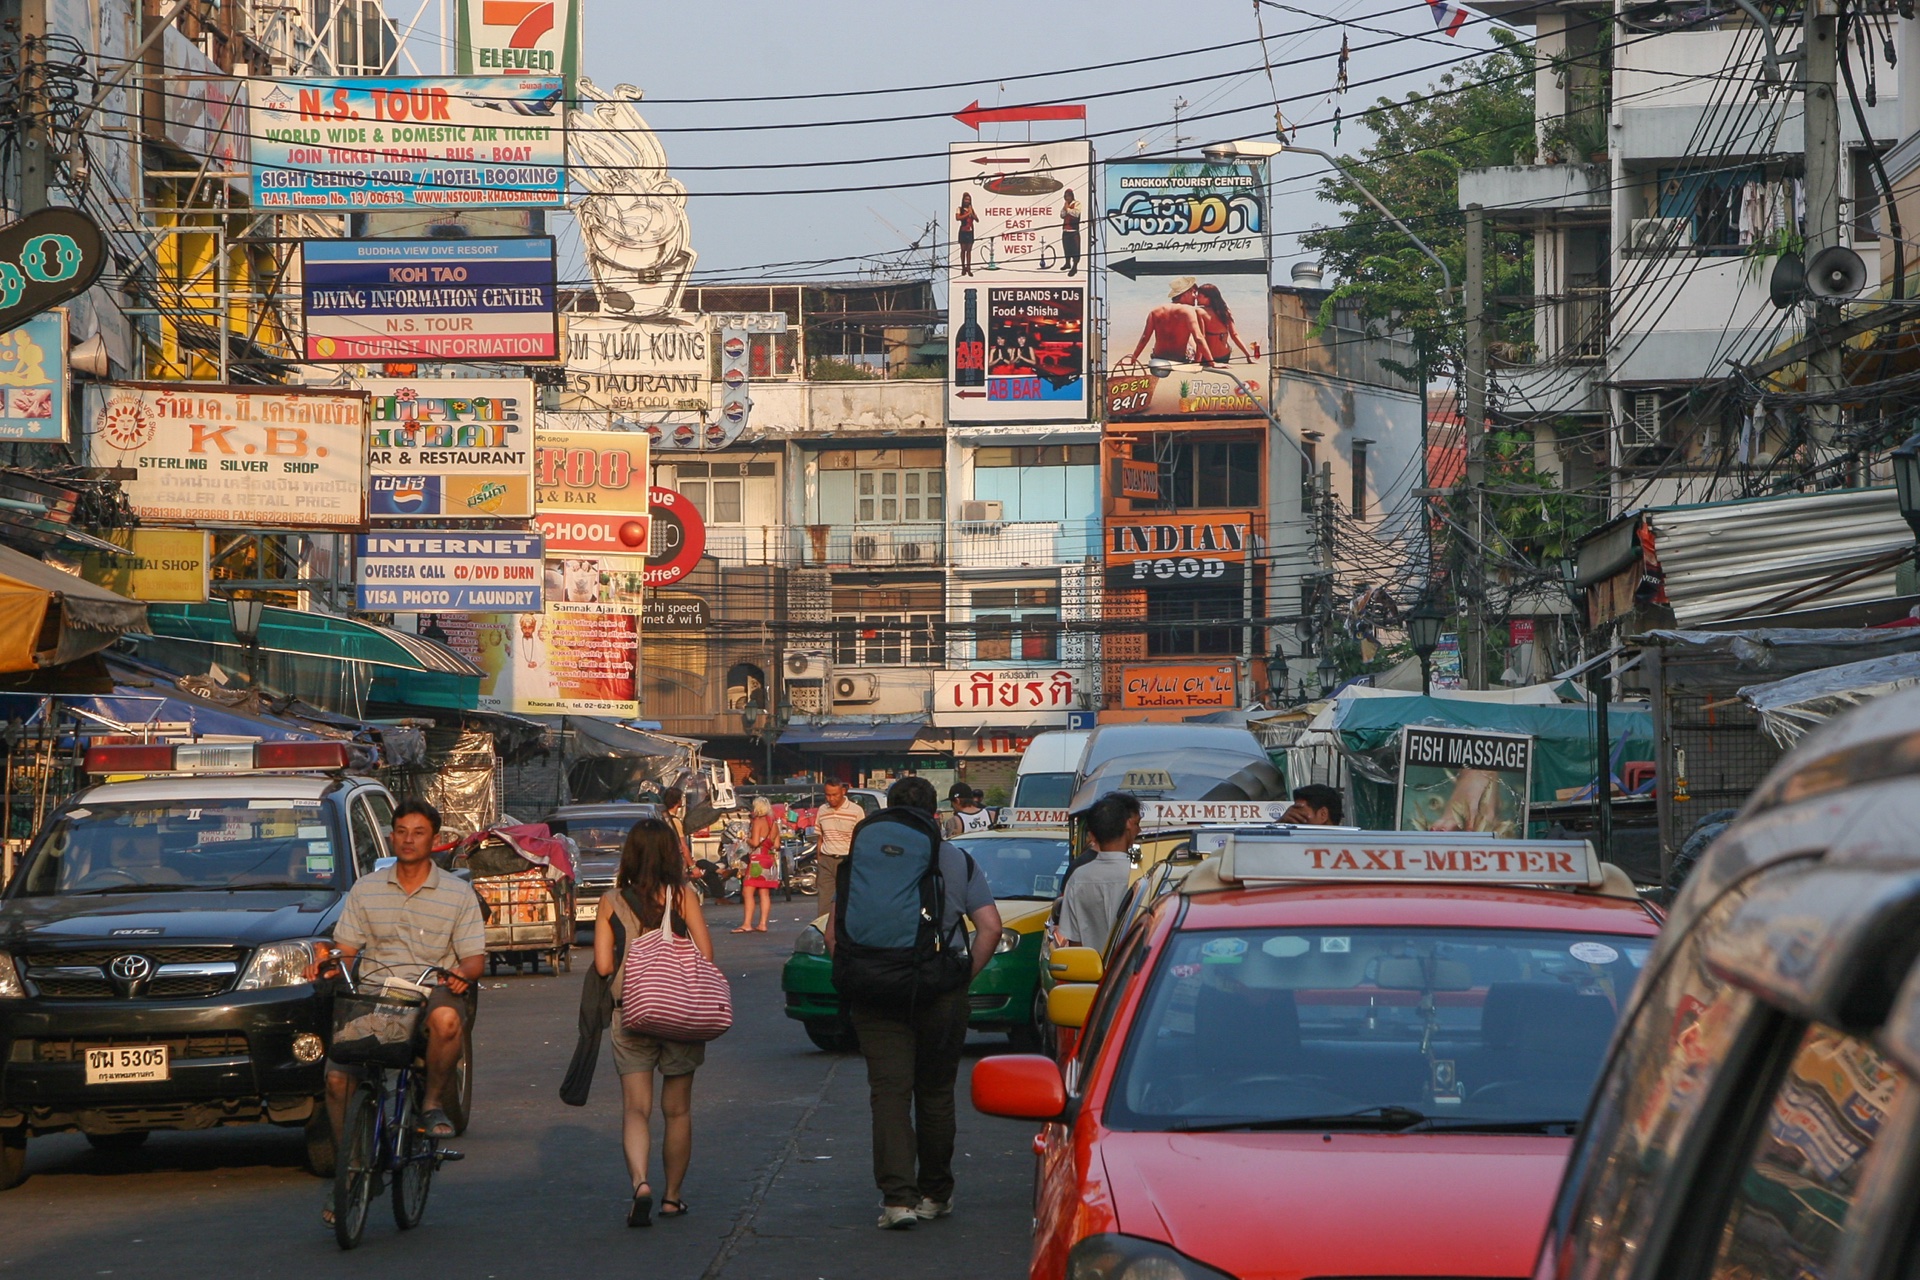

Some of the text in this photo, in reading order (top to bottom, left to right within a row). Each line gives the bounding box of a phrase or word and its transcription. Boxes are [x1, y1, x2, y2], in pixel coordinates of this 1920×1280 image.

[482, 1, 555, 48] 7
[299, 87, 451, 122] N.S. TOUR
[265, 126, 551, 145] WORLD WIDE & DOMESTIC AIR TICKET
[287, 146, 532, 165] JOIN TICKET TRAIN BUS BOAT
[261, 170, 307, 189] SIGHT
[312, 169, 366, 188] SEEING
[371, 169, 413, 188] TOUR
[433, 168, 480, 186] HOTEL
[485, 167, 558, 186] BOOKING
[1121, 176, 1253, 188] BANGKOK TOURIST CENTER
[262, 193, 291, 207] T.A.T.
[292, 192, 328, 206] License
[329, 192, 348, 206] No.
[985, 207, 1052, 216] HERE WHERE
[1005, 219, 1032, 229] EAST
[1001, 232, 1036, 241] MEETS
[358, 245, 499, 256] BUDDHA VIEW DIVE RESORT
[1004, 245, 1033, 254] WEST
[389, 266, 468, 283] KOH TAO
[312, 287, 544, 309] DIVING INFORMATION CENTER
[992, 290, 1014, 301] LIVE
[1016, 290, 1051, 301] BANDS
[1061, 290, 1080, 301] DJs
[992, 305, 1017, 316] Food
[1026, 305, 1059, 316] Shisha
[386, 317, 473, 332] N.S. TOUR
[344, 337, 544, 357] TOURIST INFORMATION
[600, 332, 706, 362] YUM KUNG
[957, 341, 984, 357] AB
[956, 356, 985, 370] BAR
[988, 379, 1042, 399] AB BAR
[1111, 378, 1150, 396] OPEN
[1190, 380, 1230, 396] Free
[612, 396, 633, 409] SEA
[637, 396, 669, 409] FOOD
[1112, 393, 1148, 412] 24/7
[1195, 396, 1263, 411] INTERNET
[188, 424, 329, 458] K.B.
[139, 456, 320, 474] STERLING SILVER SHOP
[398, 451, 412, 465] &
[419, 451, 526, 465] RESTAURANT
[1123, 467, 1158, 494] INDIAN FOOD
[238, 493, 290, 508] RETAIL
[295, 495, 341, 509] PRICE
[547, 490, 559, 503] &
[564, 491, 597, 504] BAR
[366, 538, 532, 555] INTERNET
[1110, 524, 1246, 554] INDIAN
[125, 559, 200, 571] THAI SHOP
[365, 564, 535, 581] OVERSEA CALL CD/DVD BURN
[1132, 557, 1225, 579] FOOD
[364, 589, 399, 606] VISA
[402, 589, 450, 606] PHOTO
[469, 589, 534, 606] LAUNDRY
[553, 603, 591, 613] Samnak
[654, 601, 665, 613] hi
[667, 601, 700, 615] speed
[666, 614, 676, 625] &
[679, 613, 693, 625] wi
[694, 613, 703, 625] fi
[1137, 694, 1223, 706] Indian Food
[1070, 715, 1082, 730] P
[1409, 735, 1527, 768] FISH MASSAGE
[1128, 773, 1166, 786] TAXI
[1155, 804, 1263, 819] TAXI-METER
[1304, 848, 1577, 874] TAXI-METER
[120, 1048, 163, 1068] 5305
